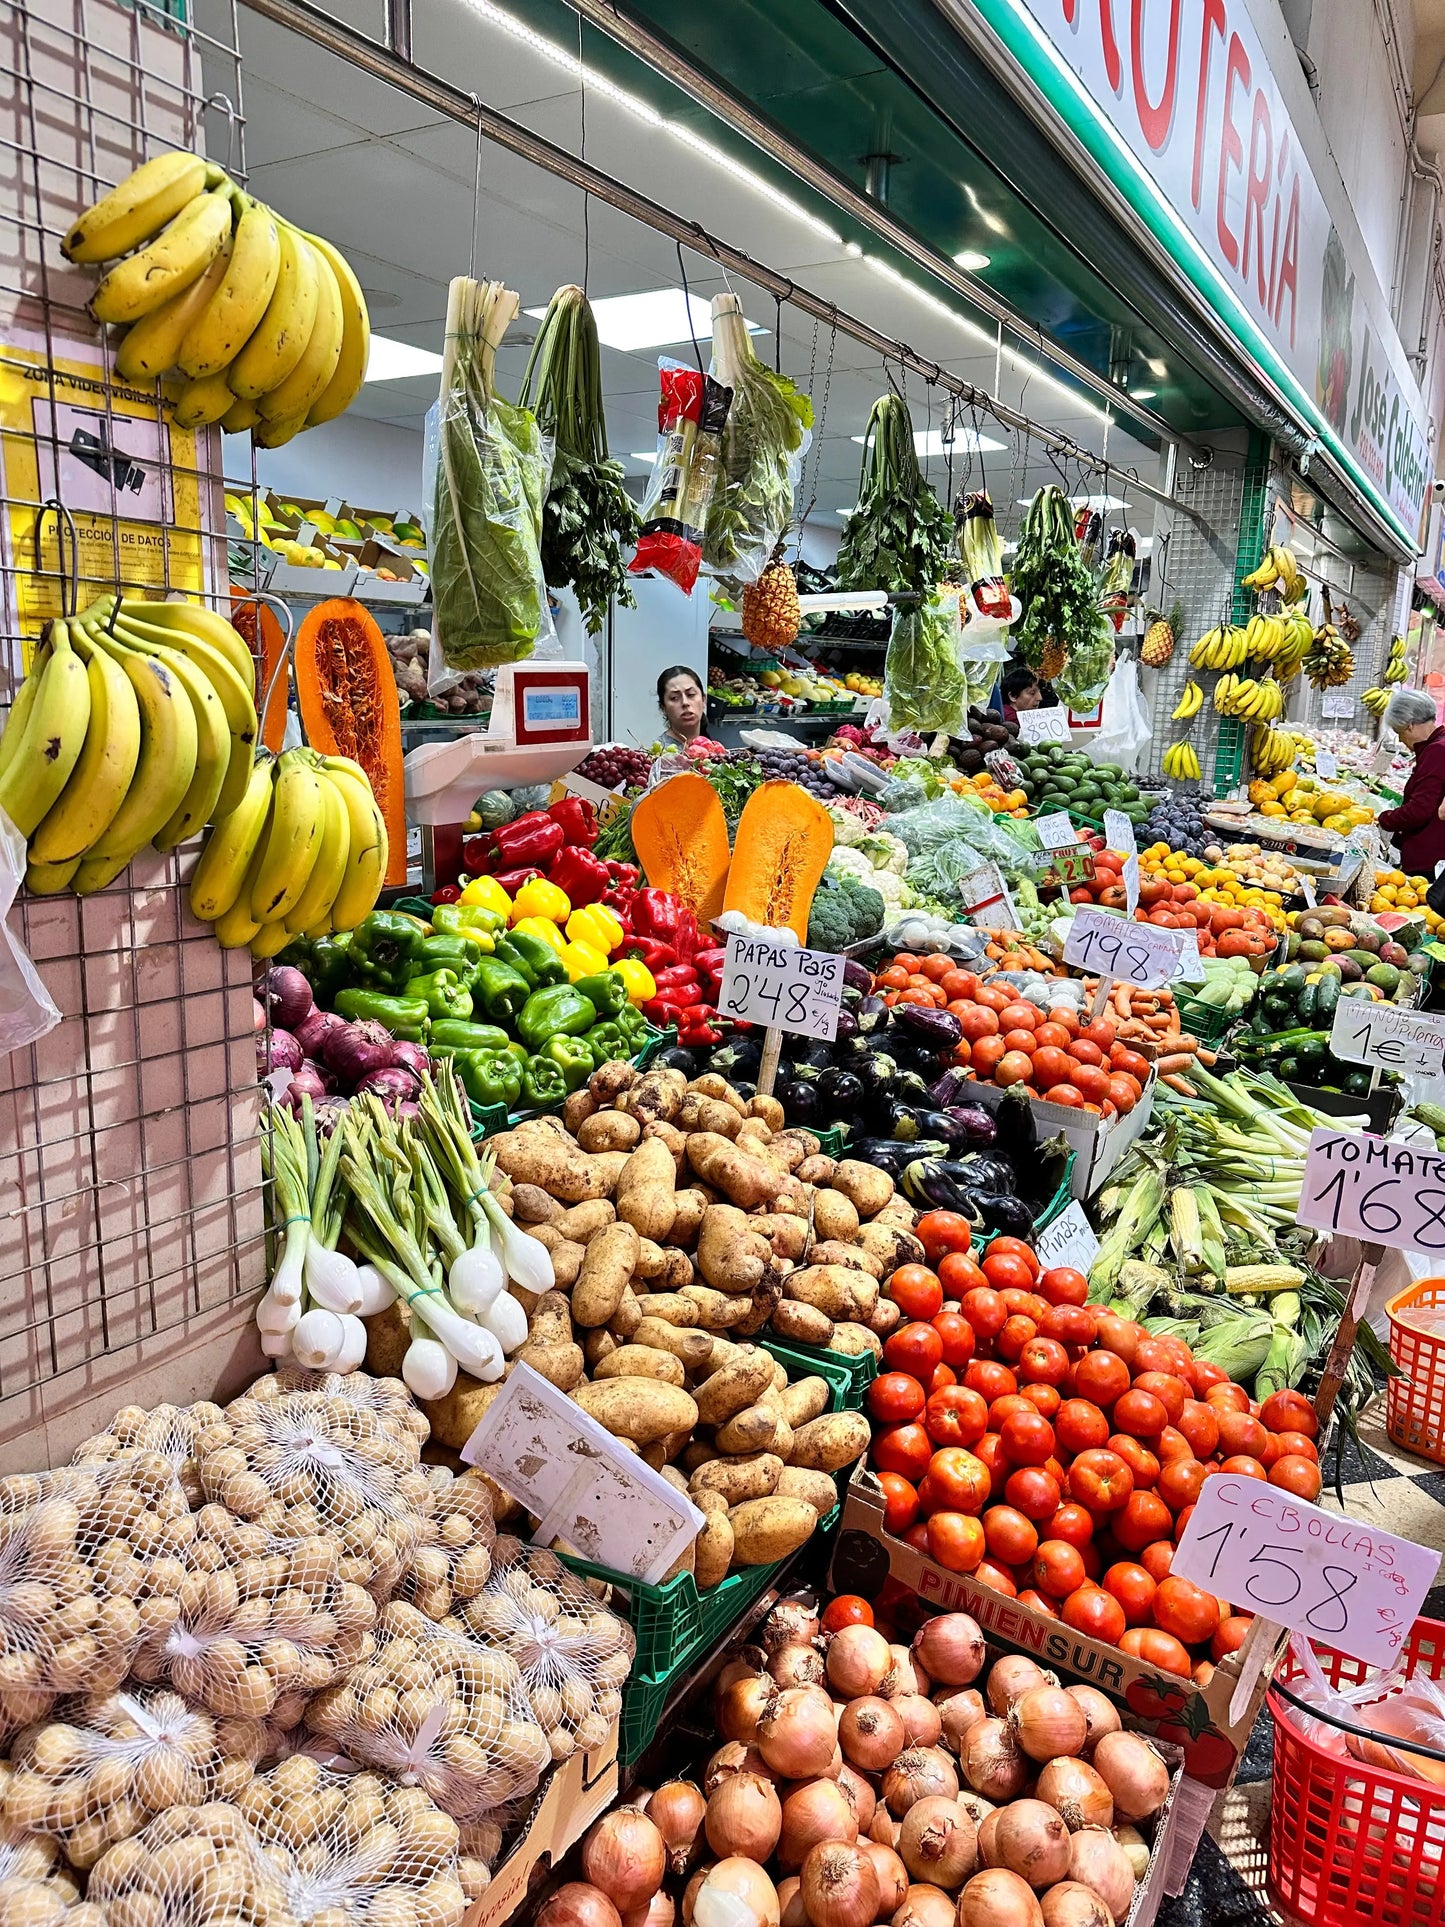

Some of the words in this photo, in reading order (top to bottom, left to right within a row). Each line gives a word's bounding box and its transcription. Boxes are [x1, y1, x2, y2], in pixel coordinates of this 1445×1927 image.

[1351, 323, 1389, 449] José
[48, 524, 117, 541] POTECCIÓ
[121, 532, 136, 544] DE
[138, 535, 172, 548] DATOS
[1082, 911, 1152, 942] TOMATES
[735, 940, 788, 968] PAPAS
[1077, 930, 1150, 981] 1'98
[728, 974, 811, 1023] 2'48
[1352, 1022, 1406, 1064] 1€
[1217, 1483, 1396, 1566] CEBOLLAS
[1197, 1522, 1358, 1632] 1'58
[917, 1566, 1126, 1690] PIMIENSUR
